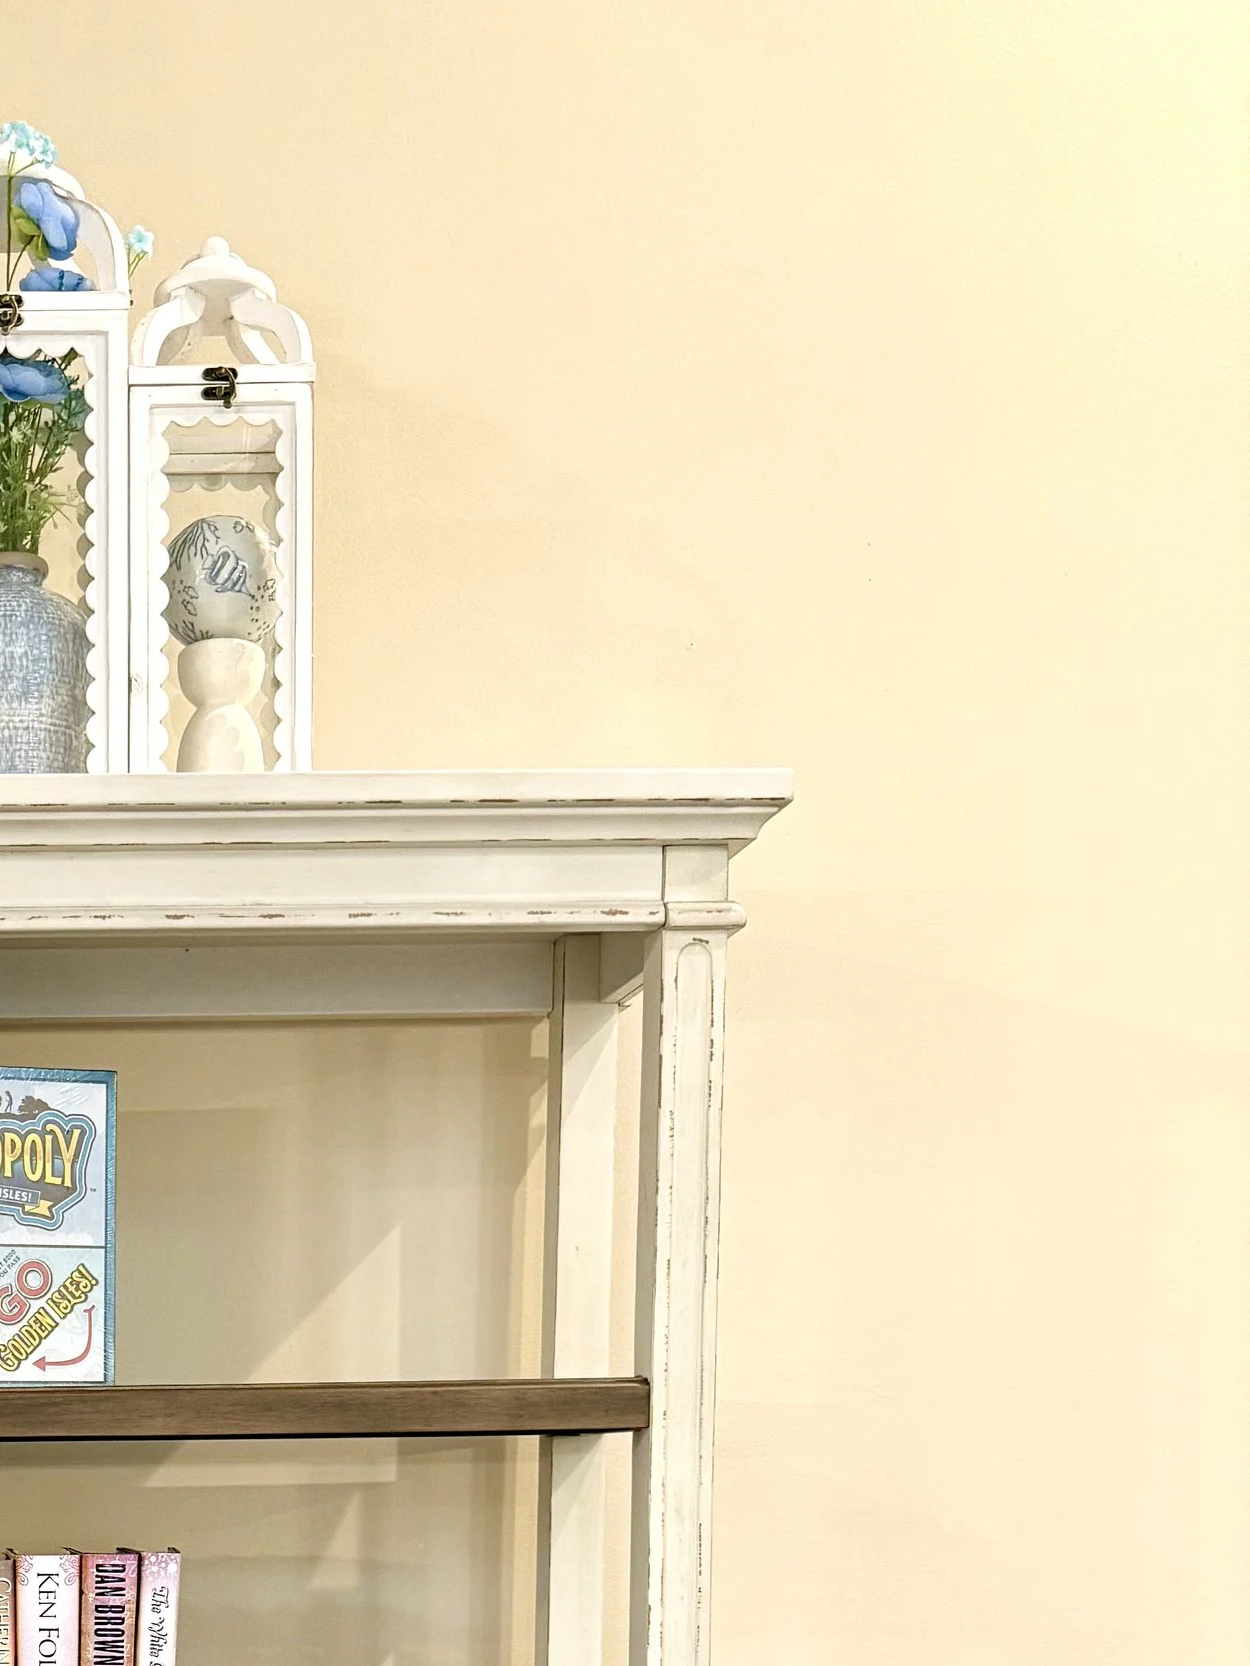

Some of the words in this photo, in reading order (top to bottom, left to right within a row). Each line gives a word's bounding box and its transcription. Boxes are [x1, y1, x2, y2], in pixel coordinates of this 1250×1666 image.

[46, 1262, 99, 1319] ISLES!
[37, 1572, 60, 1619] KEN
[95, 1563, 126, 1597] DAN
[151, 1586, 170, 1614] The
[93, 1604, 126, 1666] BROWN
[147, 1616, 168, 1659] White
